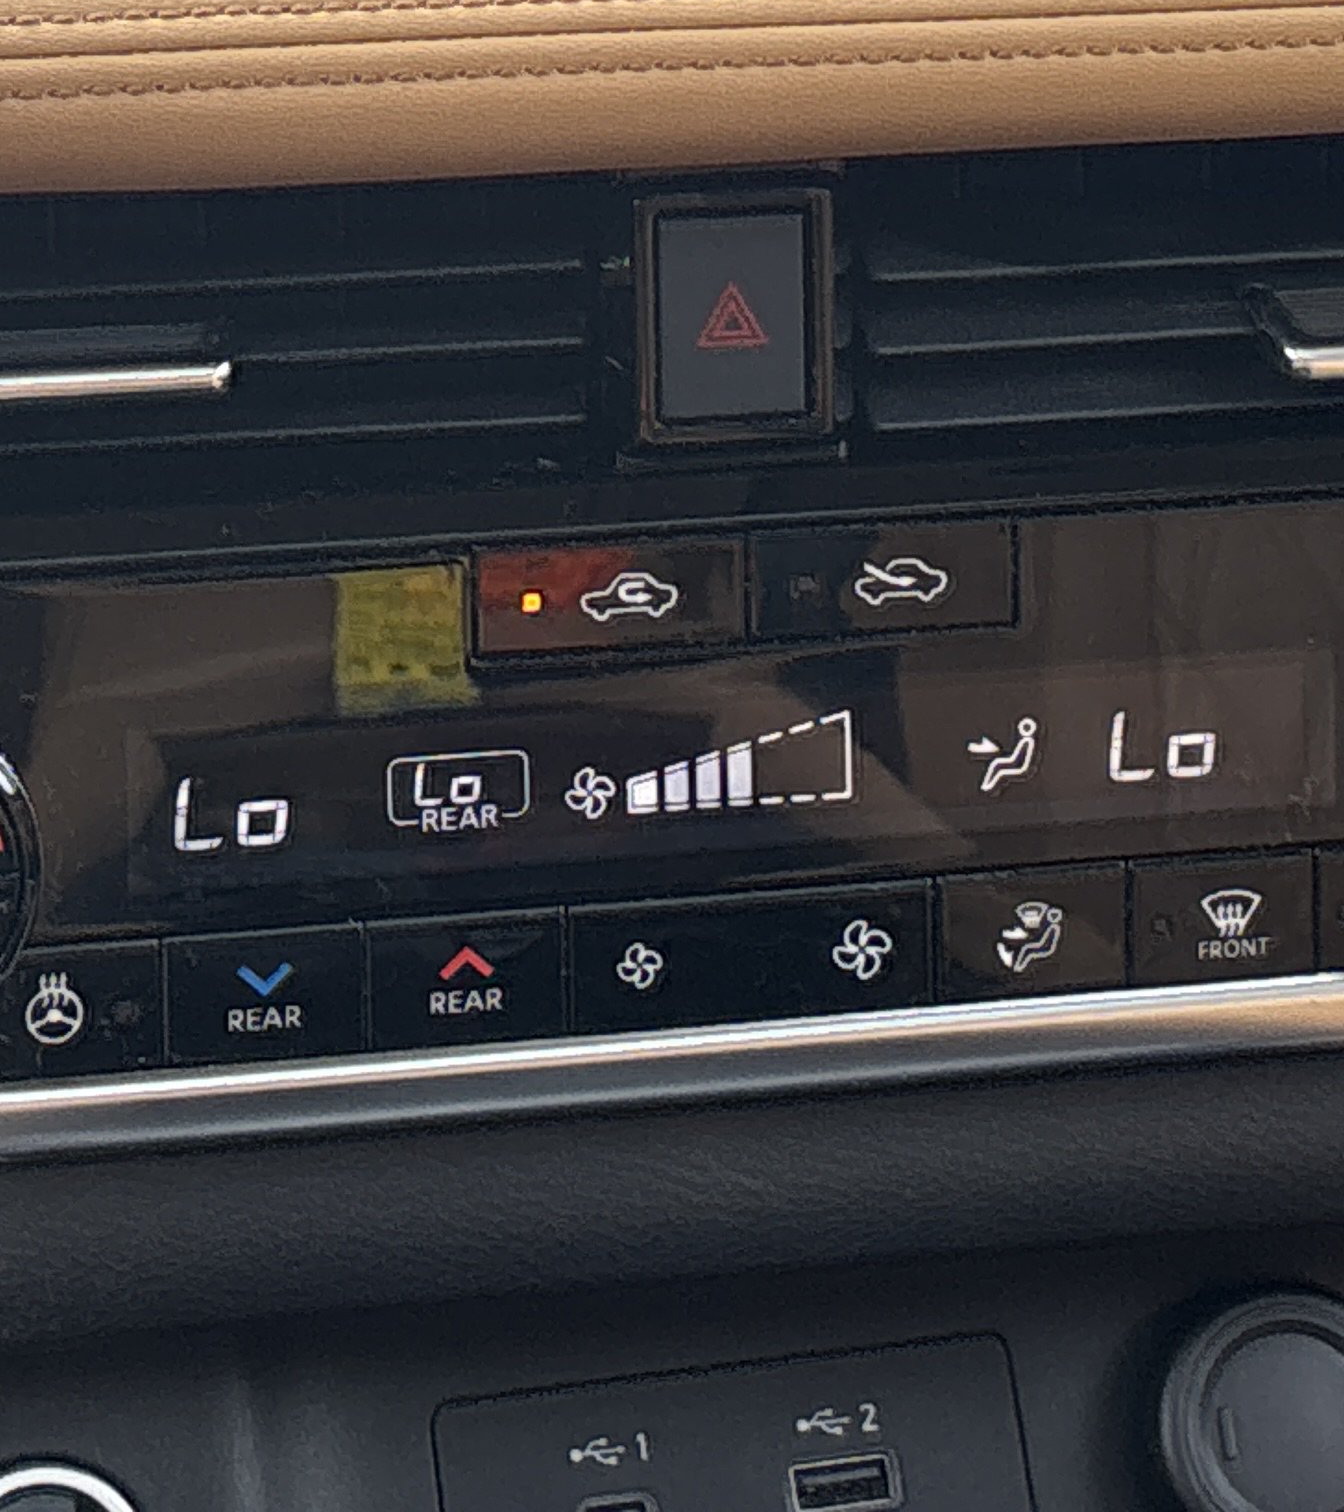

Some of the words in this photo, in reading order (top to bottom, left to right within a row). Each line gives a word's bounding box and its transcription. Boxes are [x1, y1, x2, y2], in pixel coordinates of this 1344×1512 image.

[1109, 711, 1216, 782] Lo
[174, 778, 289, 851] Lo
[421, 803, 499, 833] REAR
[1197, 936, 1271, 960] FRONT
[430, 988, 503, 1014] REAR
[228, 1005, 301, 1032] REAR
[859, 1403, 879, 1432] 2
[636, 1433, 649, 1461] 1
